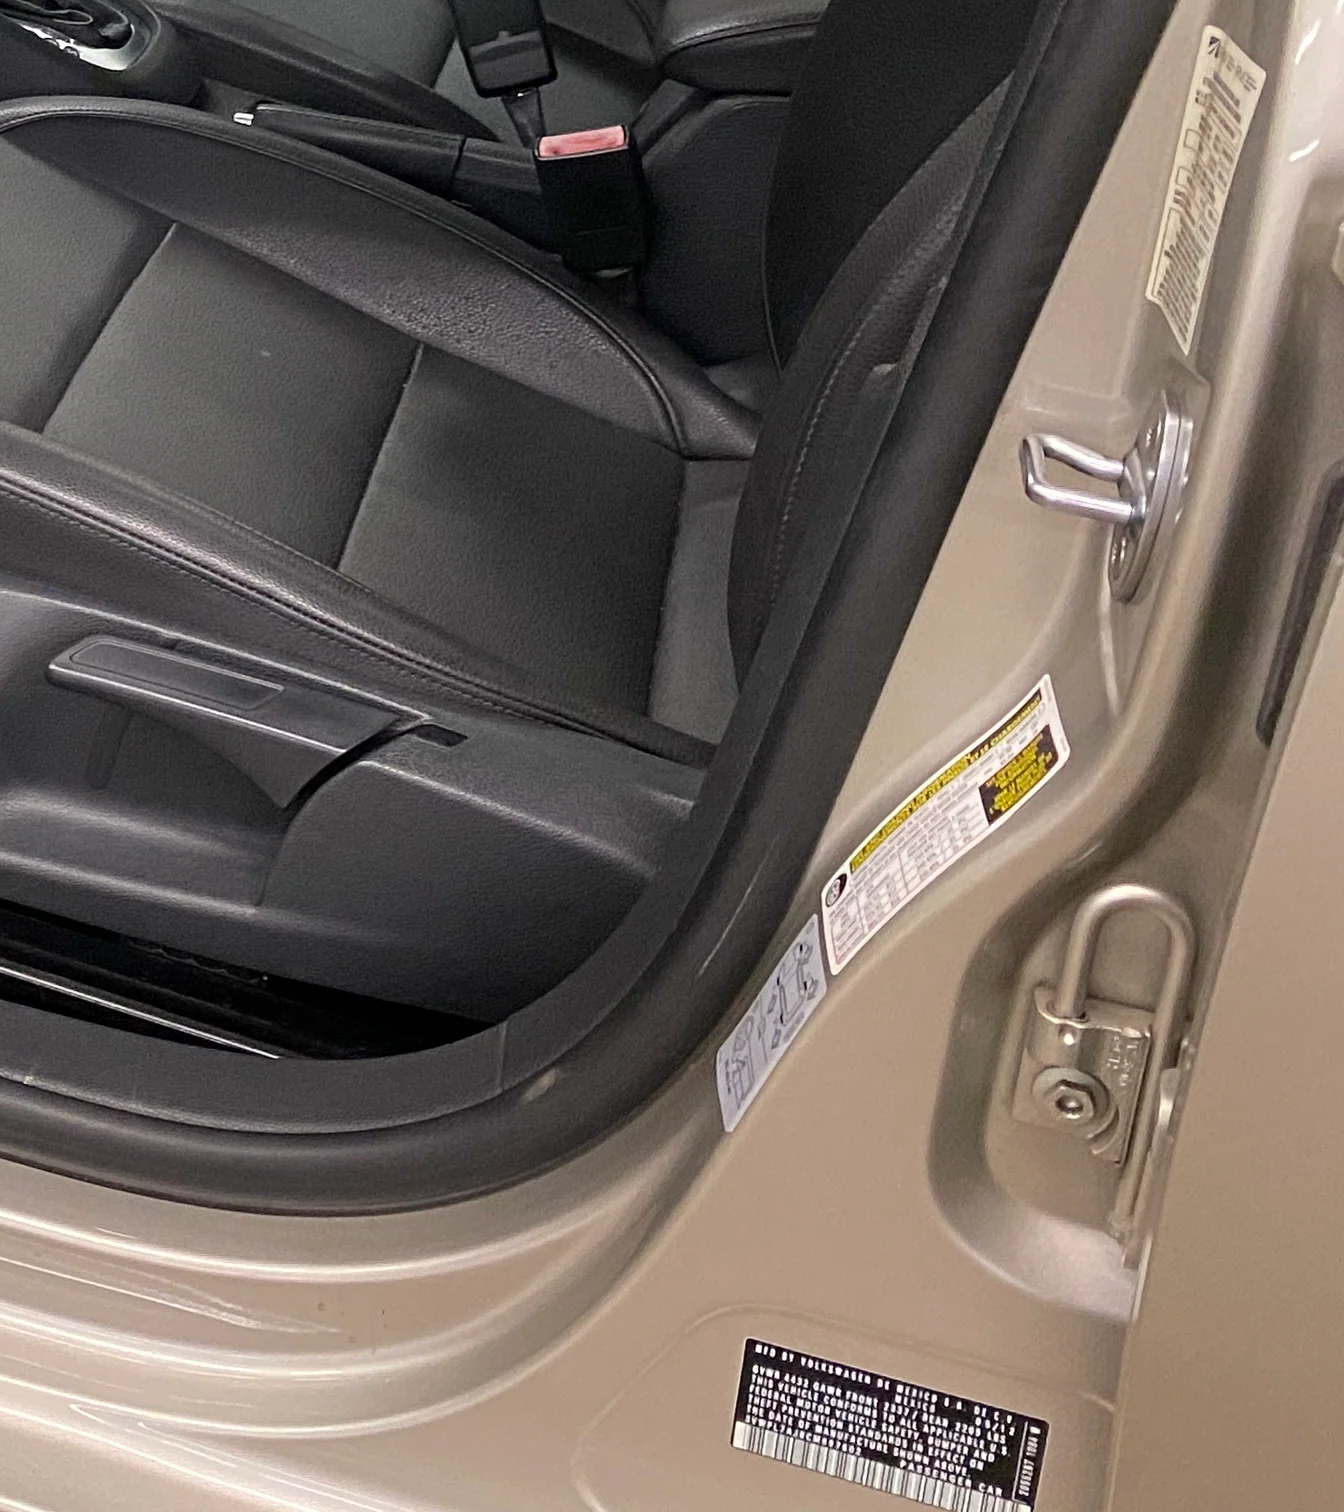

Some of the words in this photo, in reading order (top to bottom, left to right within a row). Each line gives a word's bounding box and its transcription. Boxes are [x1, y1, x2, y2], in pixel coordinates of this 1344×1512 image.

[800, 1356, 870, 1384] VOLKSWAGEN
[896, 1383, 937, 1403] MEXICO
[812, 1381, 841, 1396] GAWR
[845, 1390, 877, 1407] FRONT
[894, 1394, 935, 1412] MEXICO
[746, 1404, 763, 1416] THE
[768, 1410, 792, 1425] DATE
[797, 1419, 809, 1430] OF
[814, 1424, 887, 1452] MANUFACTURE
[893, 1446, 929, 1464] SHOWN
[748, 1394, 776, 1410] THEFT
[781, 1404, 843, 1429] PREVENTION
[848, 1423, 907, 1447] STANDARDS
[928, 1446, 964, 1464] EFFECT
[969, 1458, 983, 1469] ON
[749, 1384, 791, 1404] FEDERAL
[796, 1397, 830, 1415] MOTOR
[834, 1408, 876, 1428] VEHICLE
[927, 1435, 968, 1454] BUMPER
[973, 1448, 994, 1462] AND
[751, 1375, 773, 1388] THIS
[777, 1382, 818, 1401] VEHICLE
[823, 1395, 877, 1418] CONFORMS
[882, 1412, 895, 1423] TO
[900, 1417, 917, 1429] ALL
[923, 1423, 984, 1448] APPLICABLE
[899, 1459, 971, 1487] PASSENGER
[978, 1482, 1001, 1496] CAR
